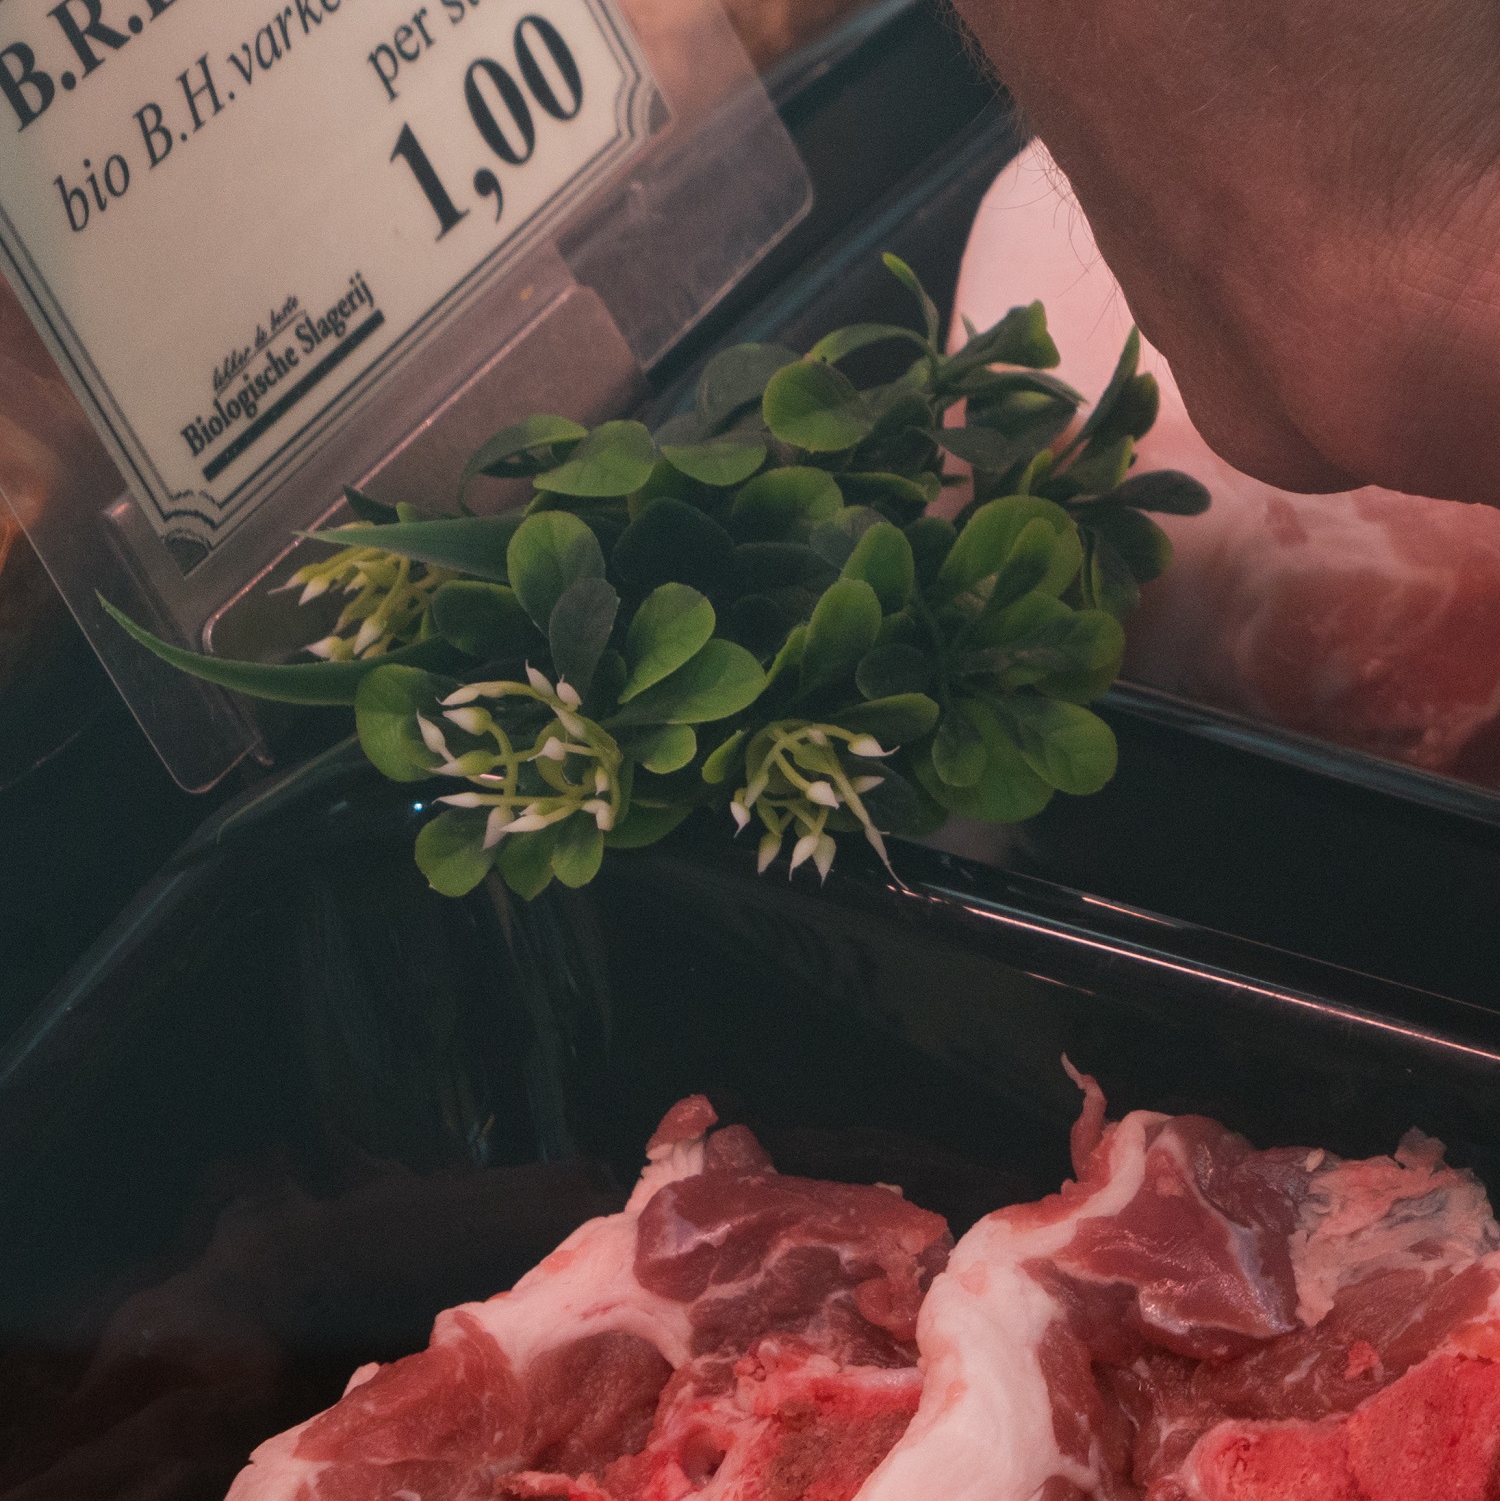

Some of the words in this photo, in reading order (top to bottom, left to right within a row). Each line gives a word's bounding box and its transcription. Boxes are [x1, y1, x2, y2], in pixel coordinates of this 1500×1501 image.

[366, 6, 436, 104] per
[52, 156, 132, 234] bio
[389, 13, 585, 244] 1,00
[180, 347, 300, 458] Biologische
[294, 269, 376, 355] Slagerij
